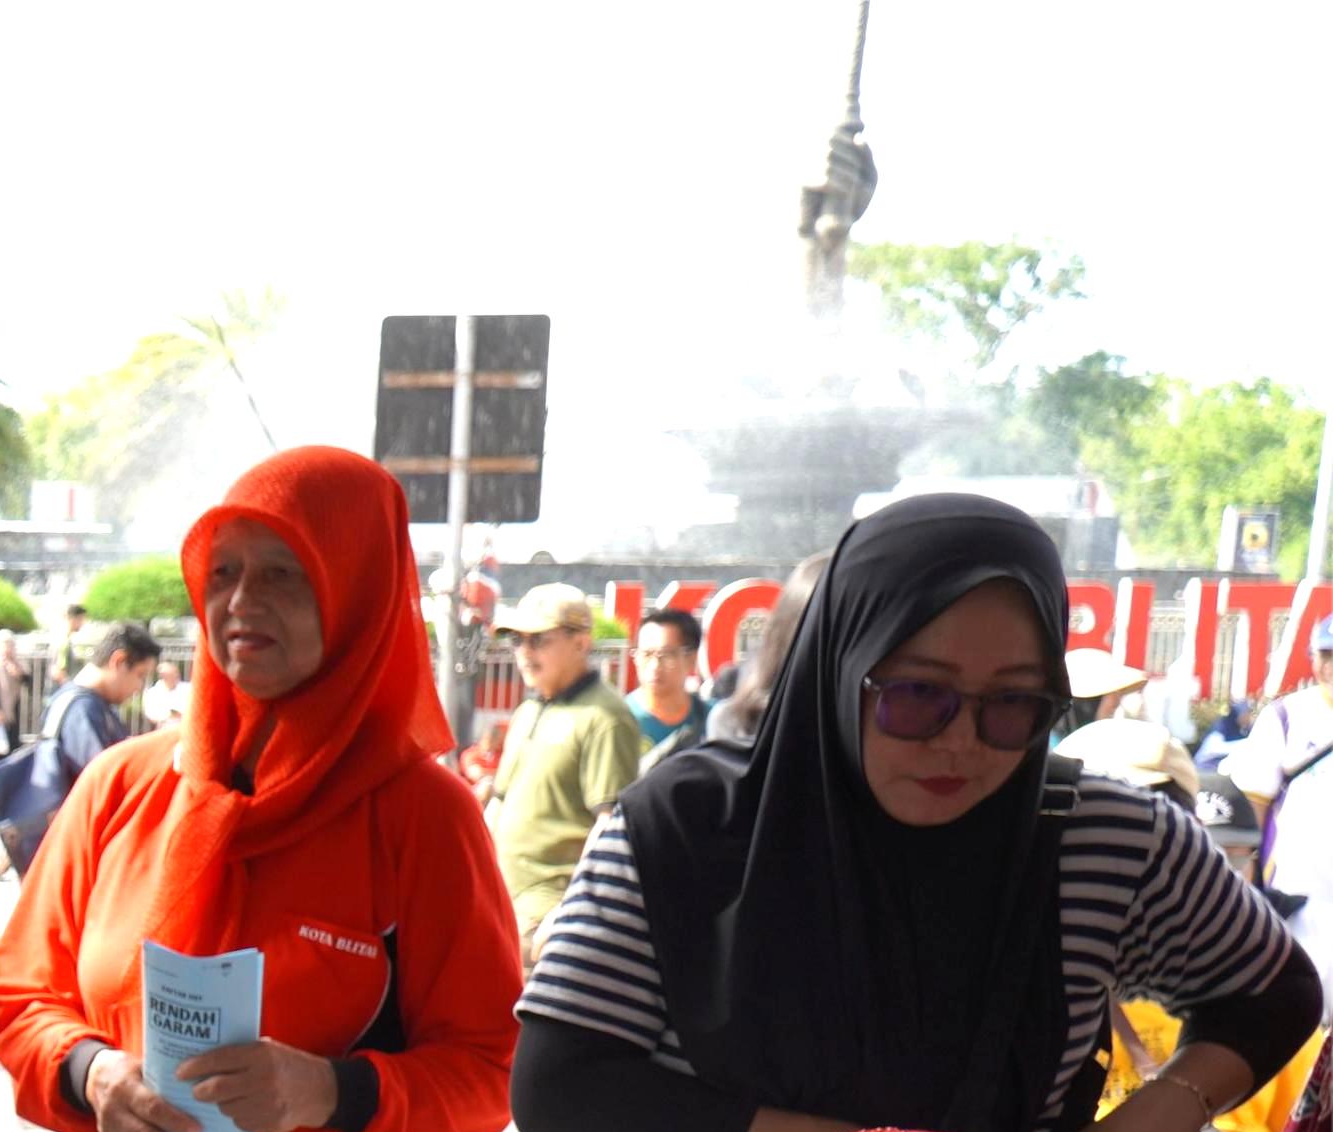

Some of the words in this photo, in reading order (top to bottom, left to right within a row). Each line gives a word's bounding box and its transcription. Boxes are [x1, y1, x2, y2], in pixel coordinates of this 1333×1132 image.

[299, 925, 333, 947] KOTA
[149, 996, 216, 1025] RENDAH
[152, 1014, 211, 1039] GARAM
